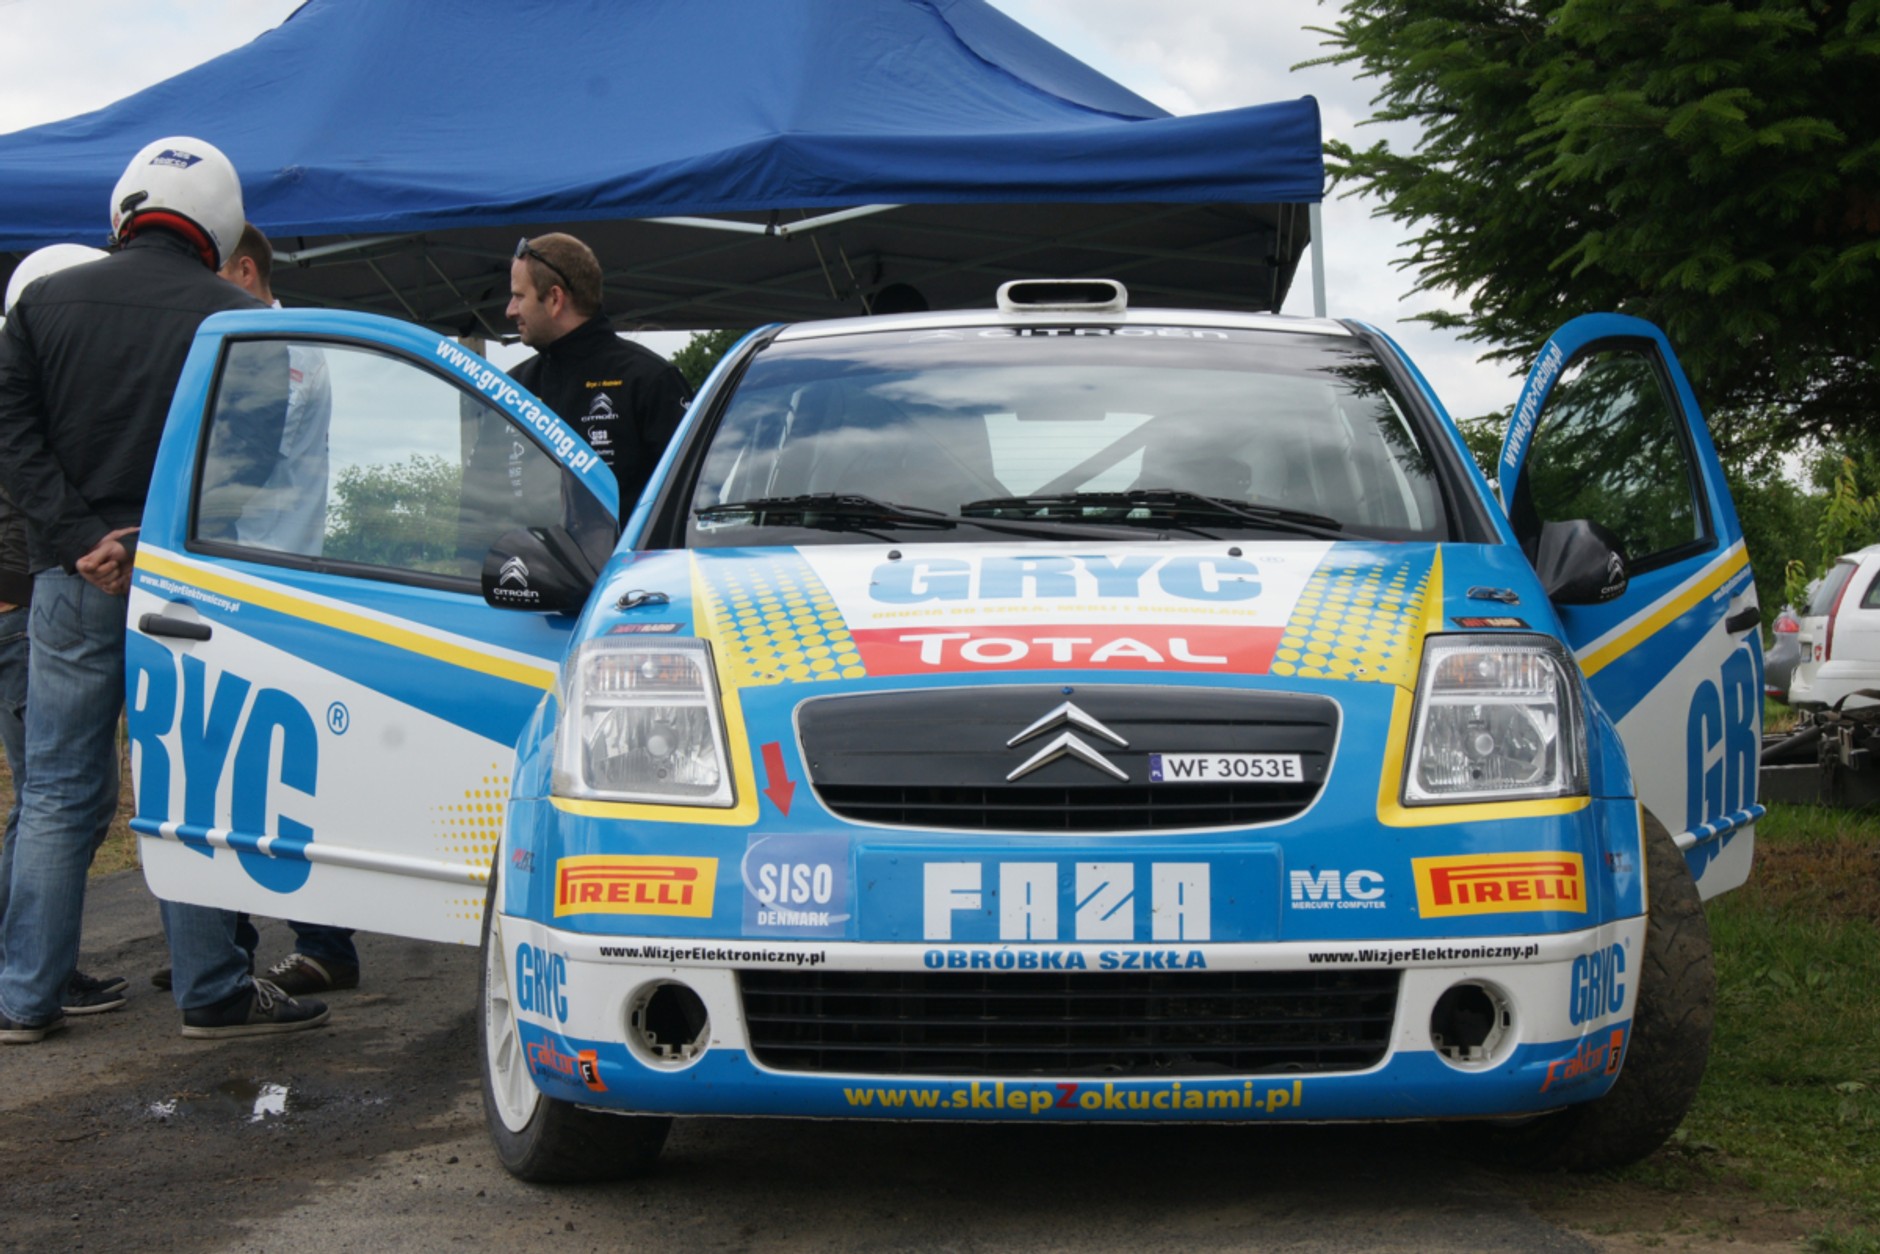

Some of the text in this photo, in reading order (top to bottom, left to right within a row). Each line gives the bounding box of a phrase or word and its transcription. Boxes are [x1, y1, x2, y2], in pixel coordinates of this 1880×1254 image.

[436, 340, 598, 474] www.gryc-racing.pl
[1504, 339, 1562, 468] www.gryc-racing.pl
[868, 555, 1262, 604] GRYC
[899, 632, 1228, 665] TOTAL
[1168, 759, 1209, 777] WF
[1217, 759, 1295, 777] 3053E
[559, 865, 698, 906] PIRELLI
[758, 863, 832, 904] SISO
[923, 862, 1210, 940] FAZA
[1290, 870, 1385, 900] MC
[1429, 861, 1578, 906] PIRELLI
[758, 911, 829, 927] DENMARK
[1292, 901, 1386, 909] MERCURY COMPUTER
[600, 946, 826, 966] www.WizjerElektroniczny.pl
[923, 945, 1208, 970] OBRÓBKA SZKŁA
[1309, 944, 1539, 965] www.WizjerElektroniczny.pl
[516, 942, 568, 1024] GRYC
[1569, 942, 1625, 1026] GRYC
[843, 1080, 1303, 1114] www.sklepZokuciami.pl
